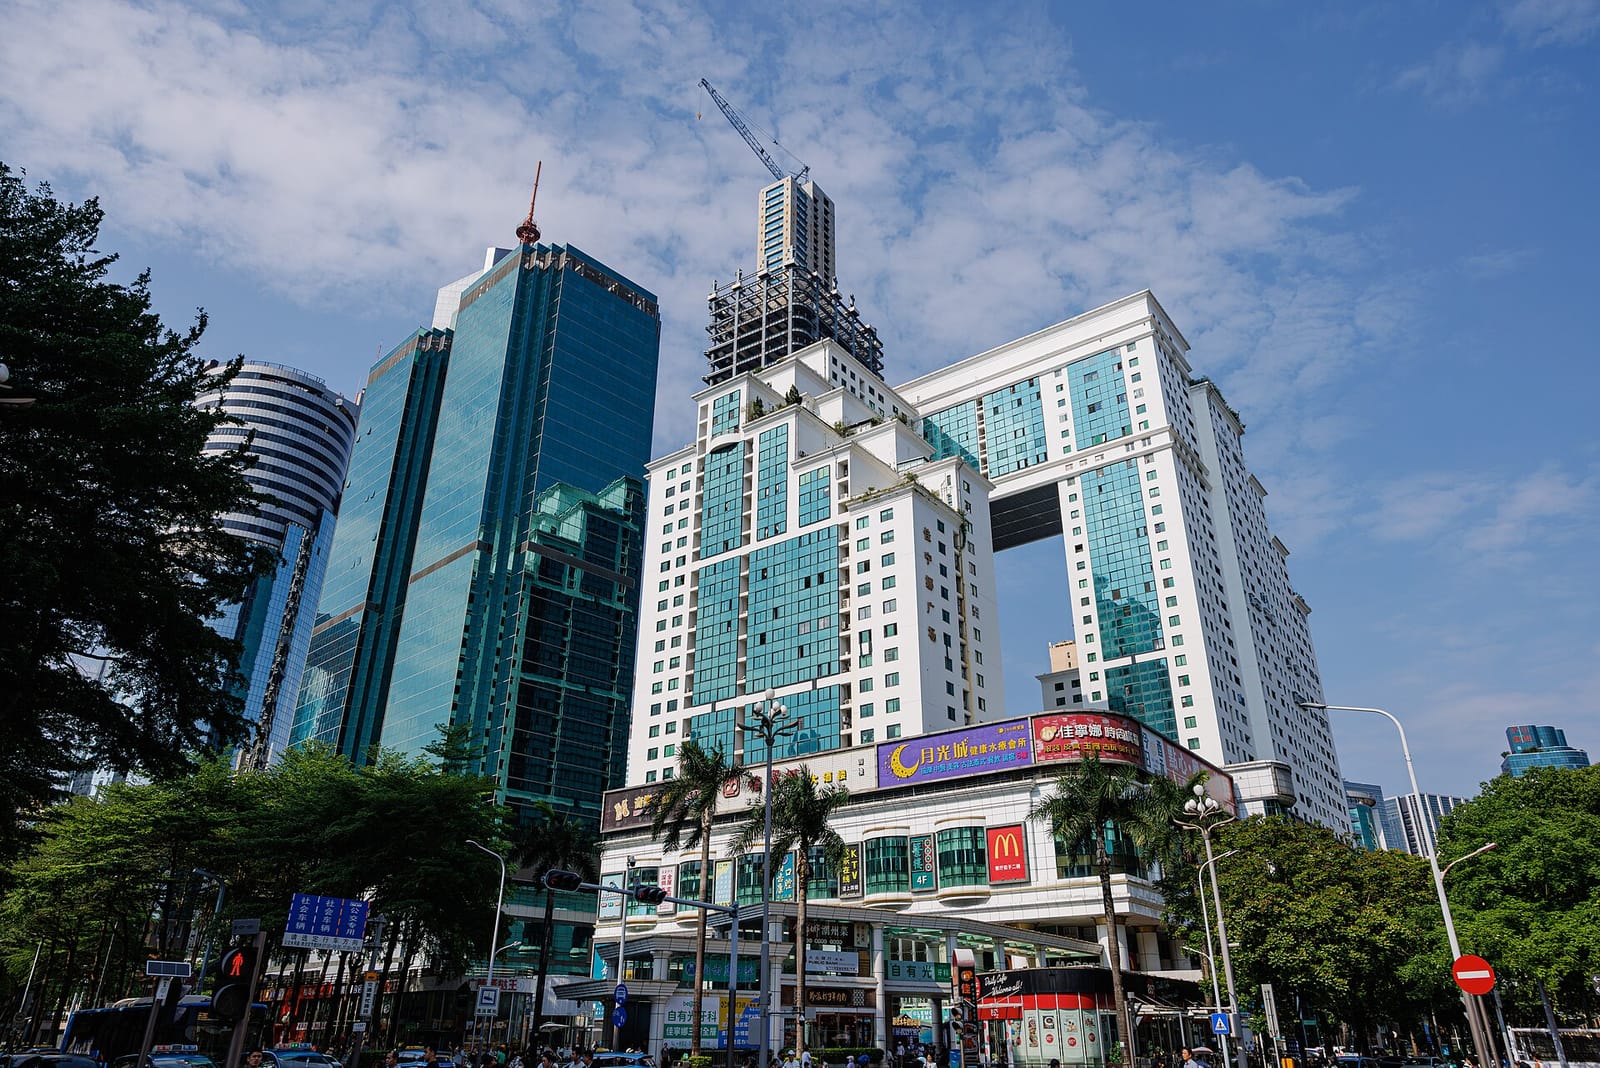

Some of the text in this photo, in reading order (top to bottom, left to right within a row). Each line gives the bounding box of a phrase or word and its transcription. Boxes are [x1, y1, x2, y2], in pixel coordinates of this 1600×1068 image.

[921, 739, 968, 764] 月光城
[916, 875, 927, 885] 4F
[891, 964, 932, 979] 自有光
